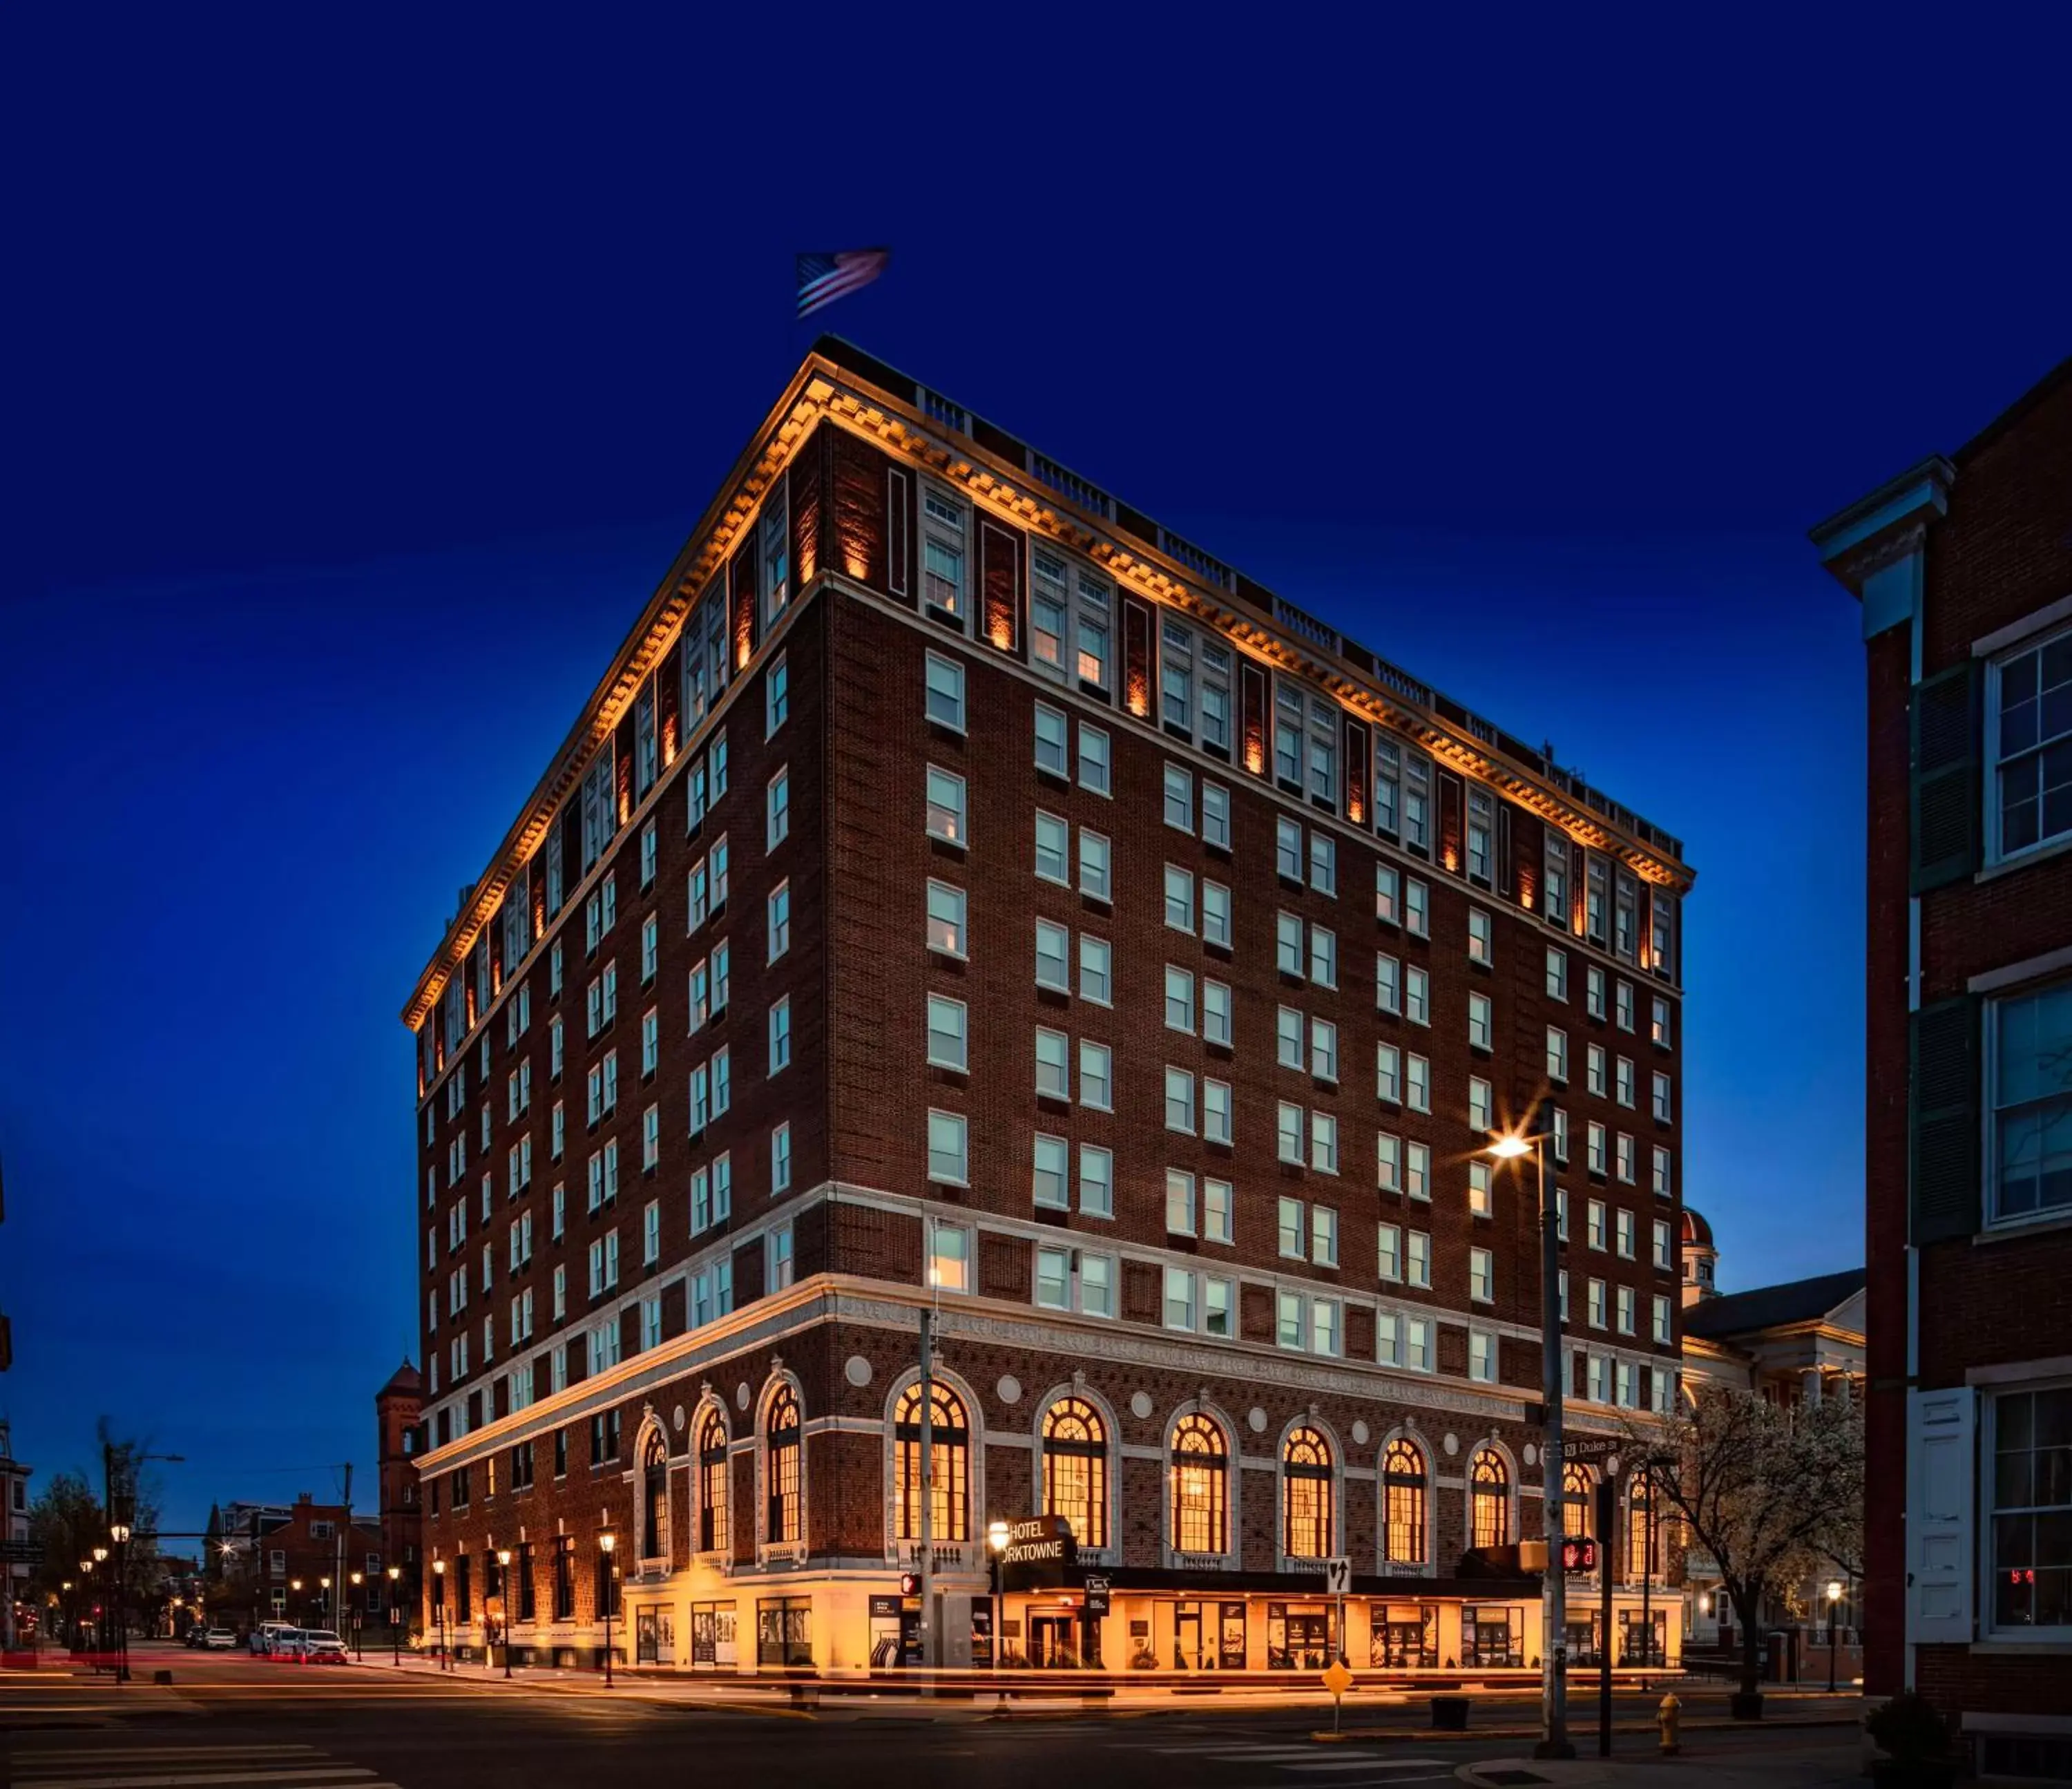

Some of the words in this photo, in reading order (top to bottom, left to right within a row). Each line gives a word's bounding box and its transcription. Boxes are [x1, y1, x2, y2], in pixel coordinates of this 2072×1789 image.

[1580, 1440, 1606, 1453] Duke
[1009, 1521, 1044, 1540] HOTEL
[1001, 1540, 1062, 1563] ORKTOWNE
